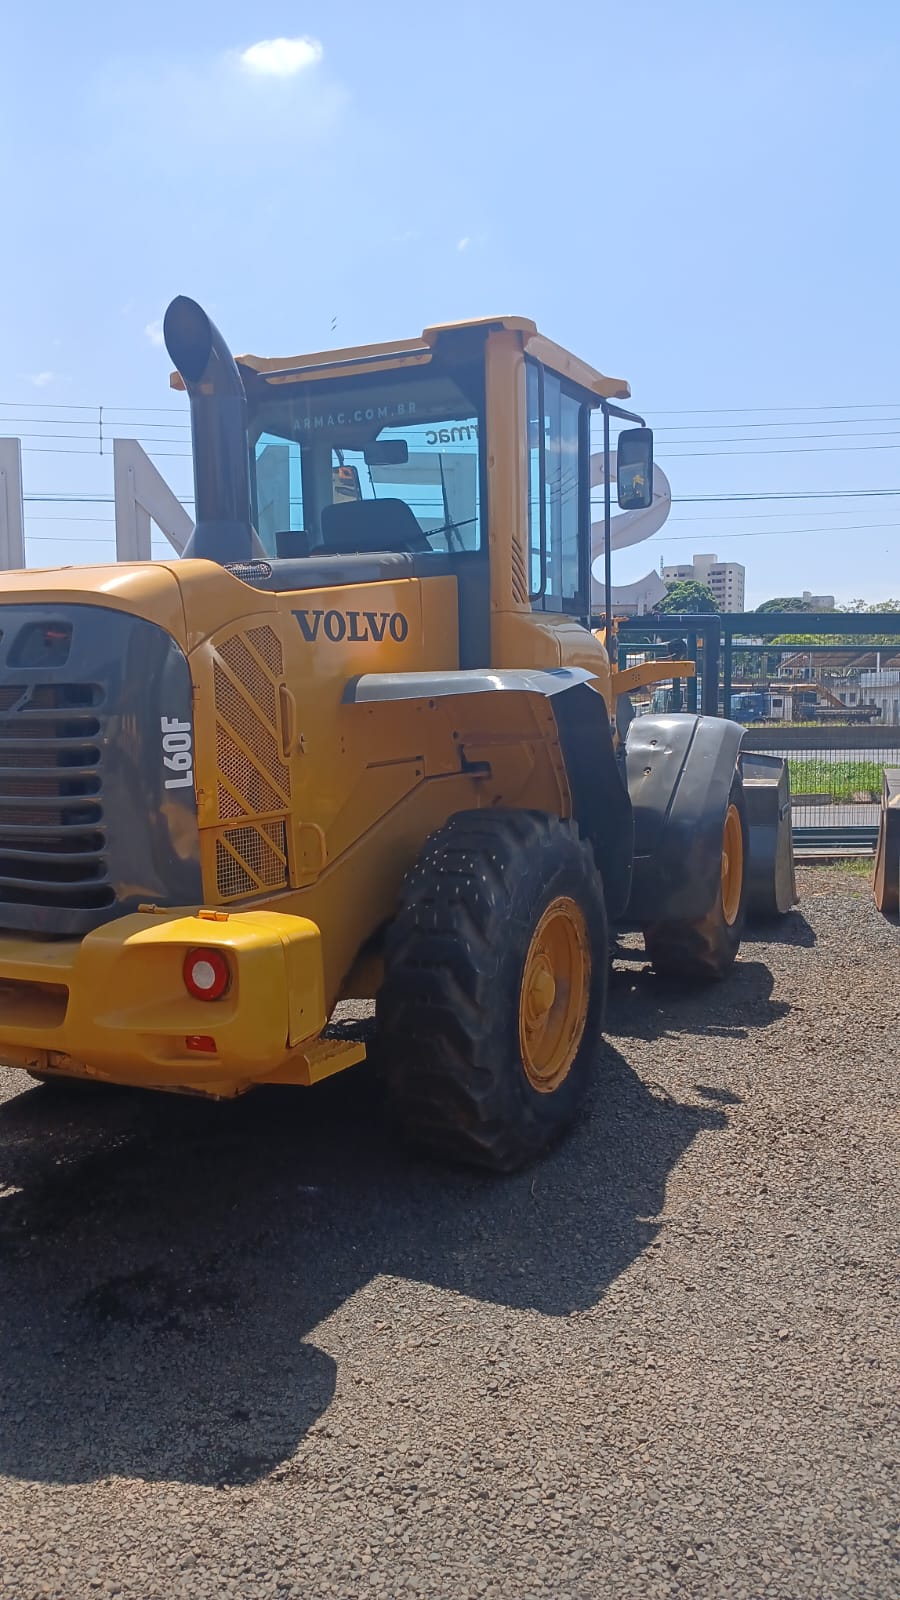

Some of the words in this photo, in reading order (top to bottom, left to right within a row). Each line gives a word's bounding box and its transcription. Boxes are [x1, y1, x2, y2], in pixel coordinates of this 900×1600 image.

[293, 402, 417, 431] ARMAC.COM.BR
[290, 609, 409, 642] VOLVO
[160, 716, 194, 790] L60F
